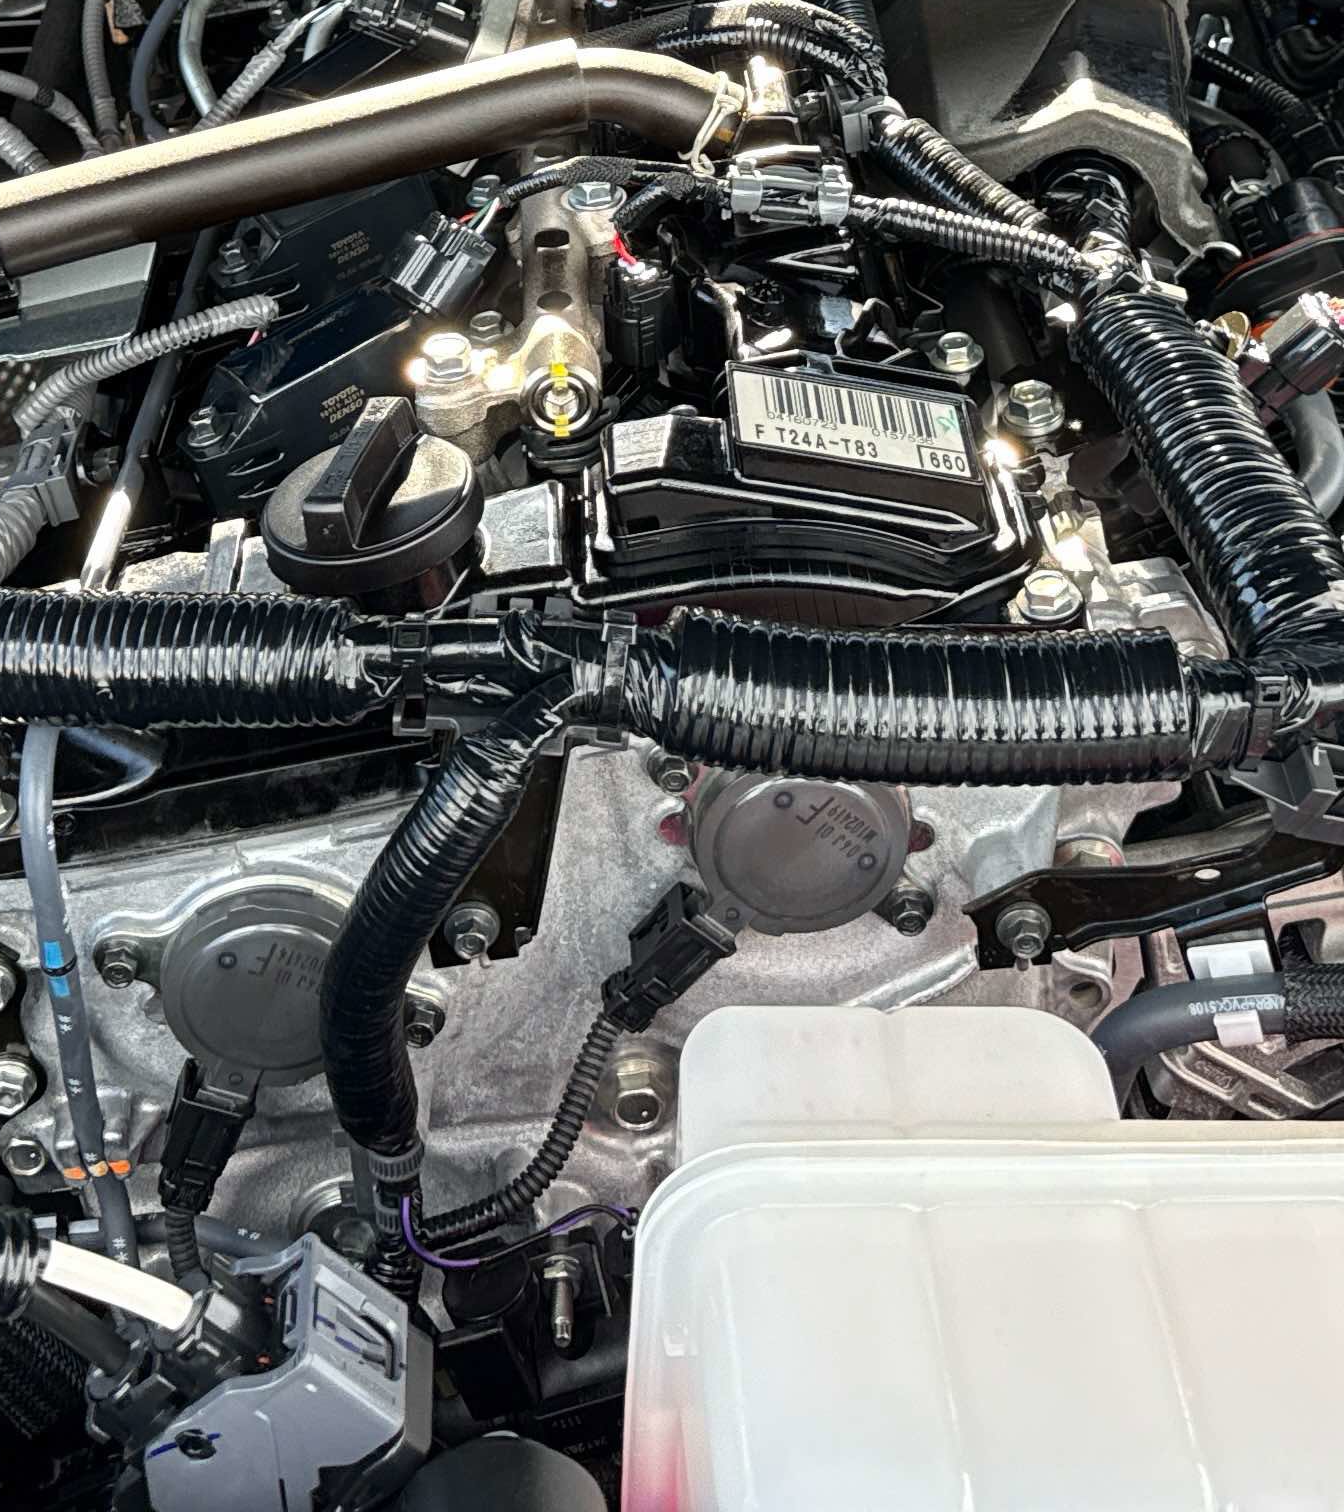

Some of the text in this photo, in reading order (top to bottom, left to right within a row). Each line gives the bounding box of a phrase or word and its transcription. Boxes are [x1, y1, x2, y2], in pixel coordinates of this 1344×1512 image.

[329, 398, 363, 424] DENSO
[755, 423, 878, 458] F T24A-T83
[929, 451, 966, 473] 660
